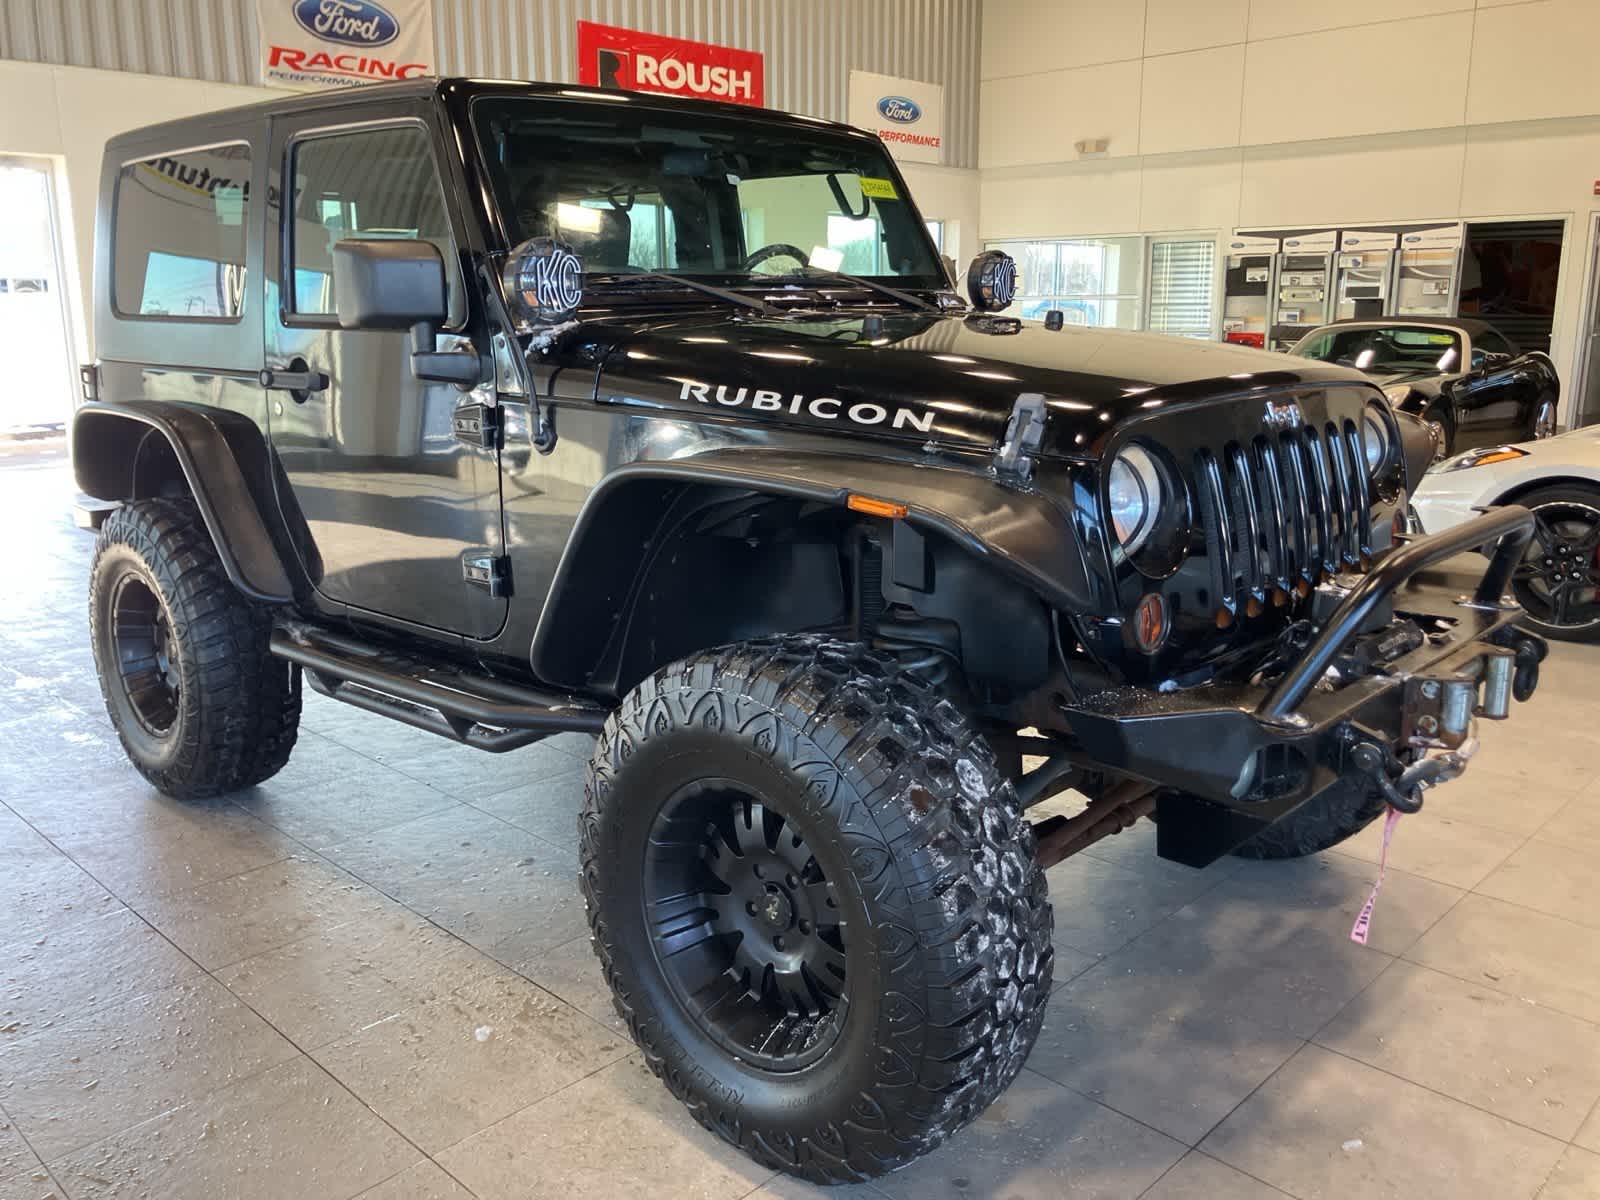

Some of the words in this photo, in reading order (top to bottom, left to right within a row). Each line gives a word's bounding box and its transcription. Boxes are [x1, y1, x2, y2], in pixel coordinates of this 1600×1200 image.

[314, 0, 380, 41] Ford
[268, 46, 428, 80] RACING
[636, 53, 752, 99] ROUSH
[886, 99, 913, 121] Ford
[879, 130, 941, 148] PERFORMANCE
[536, 249, 582, 313] KC
[993, 258, 1017, 304] KC
[679, 382, 935, 432] RUBICON
